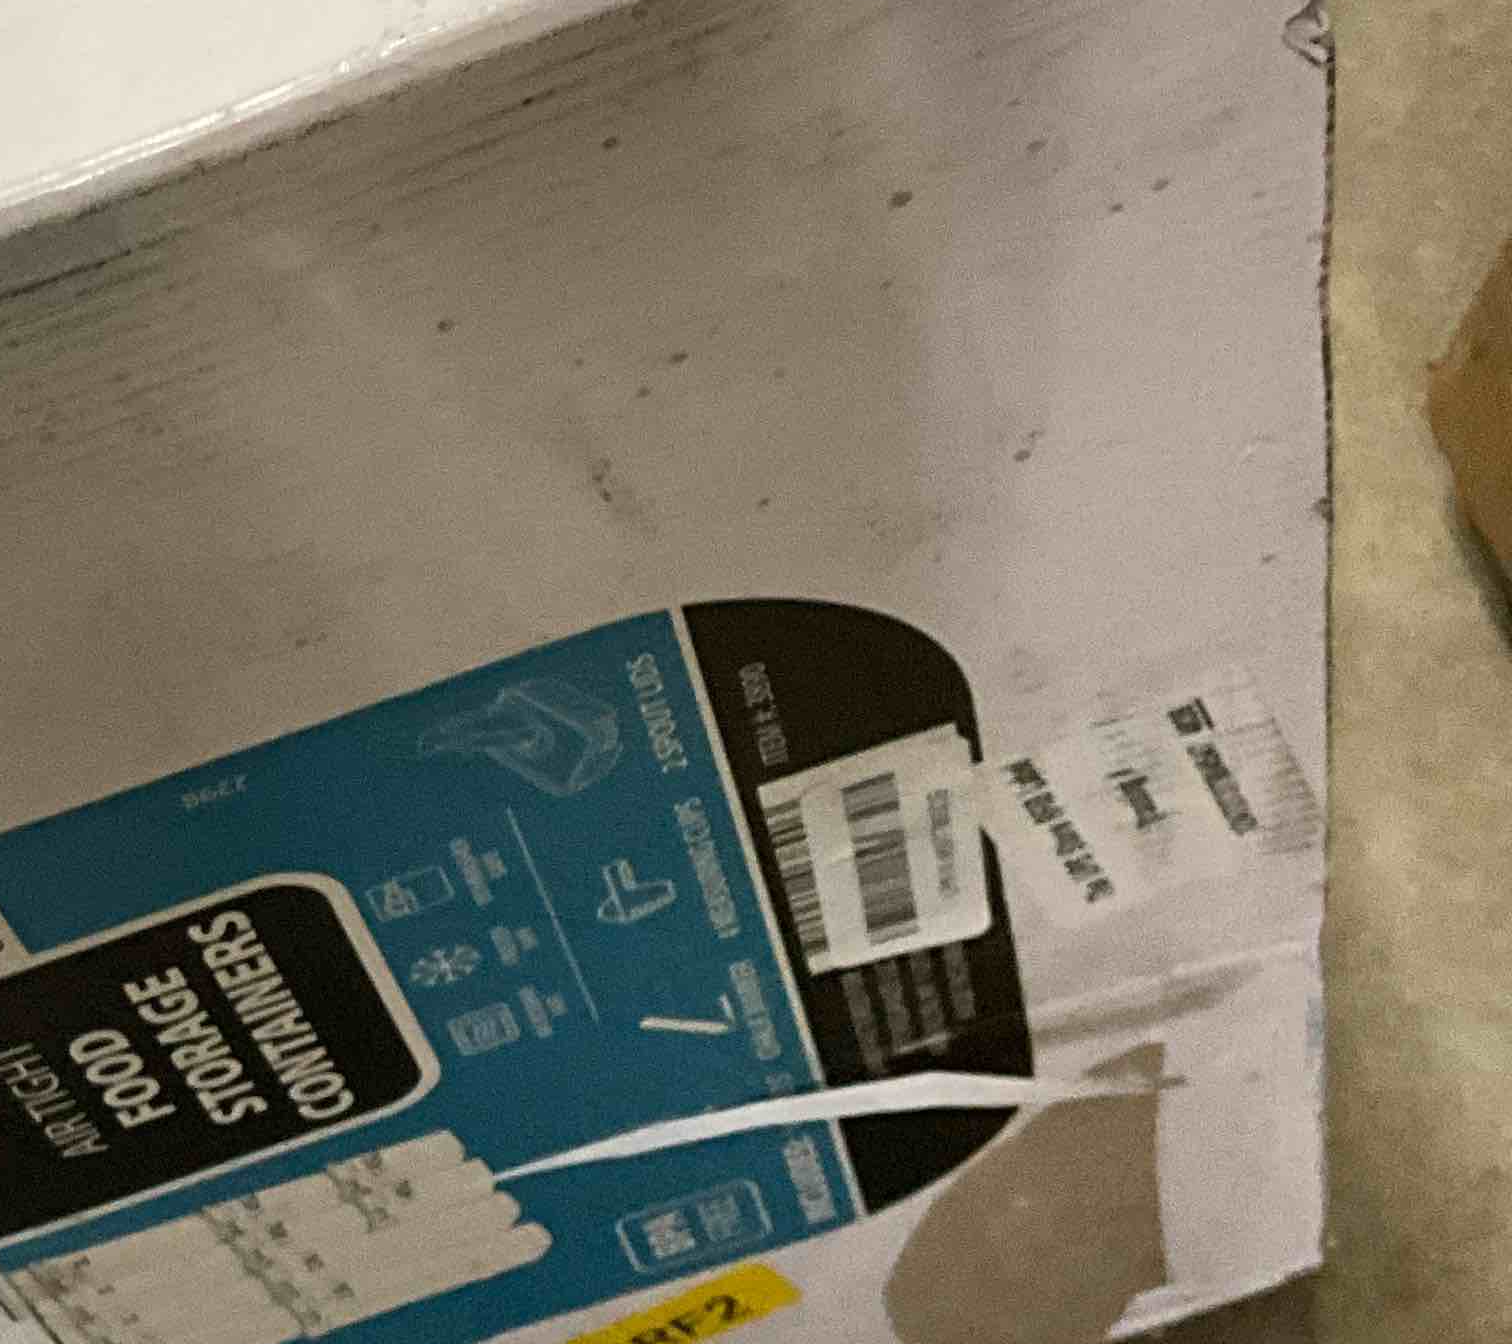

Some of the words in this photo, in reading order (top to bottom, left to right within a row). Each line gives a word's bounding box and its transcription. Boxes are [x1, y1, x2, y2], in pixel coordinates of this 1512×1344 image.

[66, 1029, 178, 1131] FOOD
[122, 967, 267, 1128] STORAGE
[189, 909, 356, 1122] CONTAINERS
